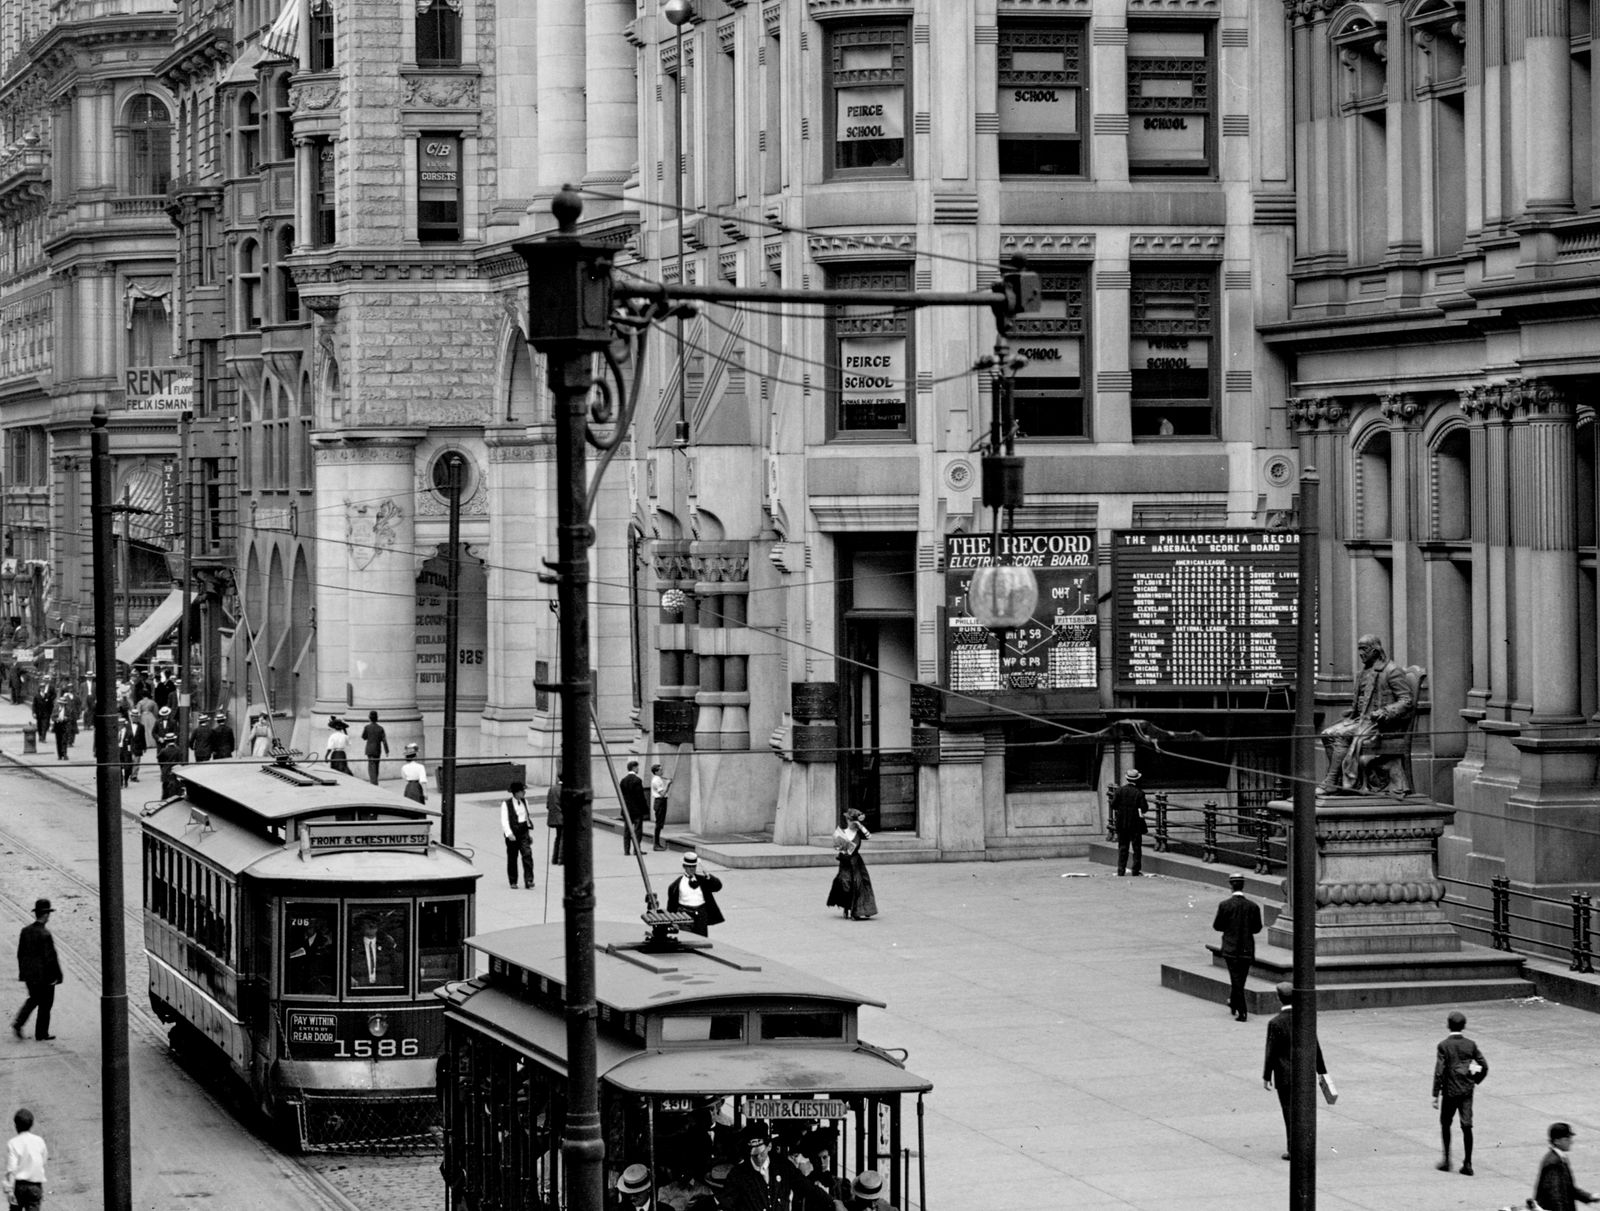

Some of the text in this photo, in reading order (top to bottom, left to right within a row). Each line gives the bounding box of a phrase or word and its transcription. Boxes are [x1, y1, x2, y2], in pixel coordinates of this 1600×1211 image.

[1014, 90, 1059, 103] SCHOOL
[847, 104, 884, 117] PEIRCE
[1144, 118, 1188, 130] SCHOOL
[846, 125, 886, 138] SCHOOL
[421, 172, 457, 181] CORSETS
[1017, 347, 1062, 360] SCHOOL
[846, 355, 891, 368] PEIRCE
[1146, 357, 1191, 369] SCHOOL
[126, 370, 193, 395] RENT Uppe
[844, 376, 894, 389] SCHOOL
[126, 400, 153, 410] FELIX
[155, 399, 187, 410] ISMAN
[164, 465, 175, 535] BILLIARDS
[1125, 534, 1300, 544] THE PHILADELPHIA RECOR
[949, 535, 1092, 556] THE RECORD
[1250, 544, 1280, 552] BOARD
[1051, 554, 1091, 566] BOARD.
[1052, 587, 1070, 599] OUT
[1057, 616, 1096, 624] PITTSBURG
[459, 649, 485, 664] 925
[310, 836, 341, 845] FRONT
[344, 836, 353, 844] &
[354, 835, 409, 844] CHESTNUT
[292, 918, 310, 926] 706
[293, 1015, 307, 1025] PAY
[293, 1032, 334, 1042] REAR DOOR
[334, 1038, 419, 1057] 1586
[662, 1099, 690, 1110] 430
